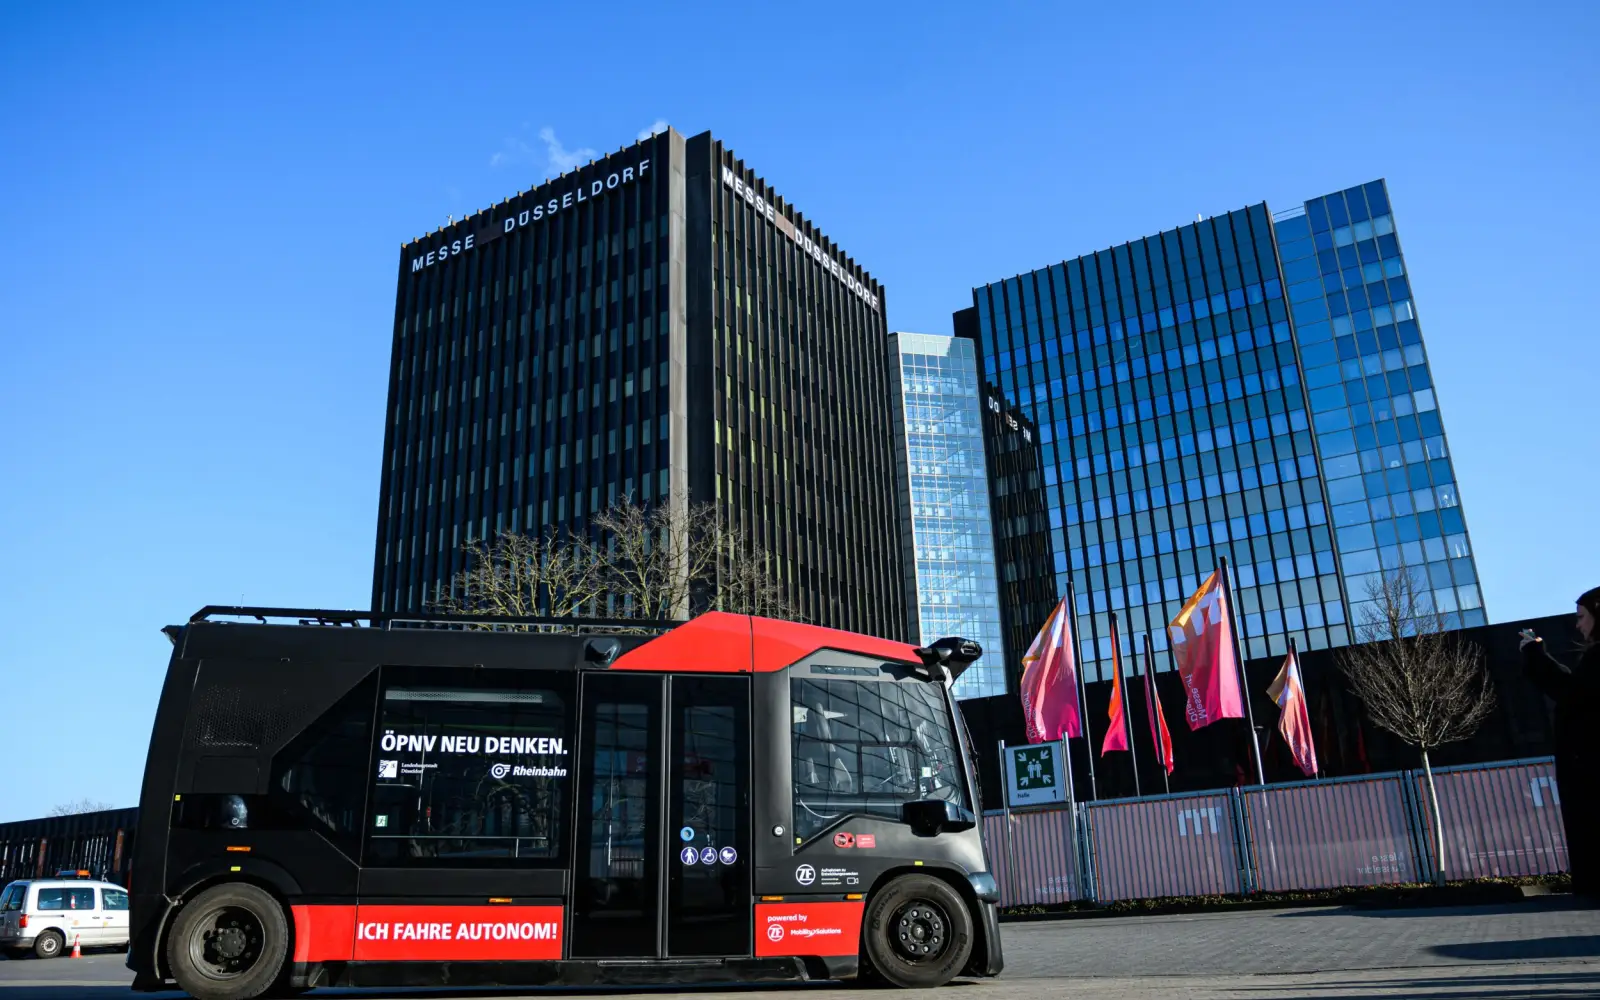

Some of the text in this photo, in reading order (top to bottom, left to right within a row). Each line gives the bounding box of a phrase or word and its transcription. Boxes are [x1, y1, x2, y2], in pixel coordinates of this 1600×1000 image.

[411, 158, 650, 273] MESSE DÜSSELDORF
[722, 165, 879, 308] MESSE DÜSSELDORF
[381, 730, 568, 755] ÖPNV NEU DENKEN.
[512, 765, 567, 777] Rheinbahn
[1052, 789, 1057, 799] 1
[796, 867, 815, 882] ZF
[767, 913, 807, 923] powered by
[357, 922, 557, 940] ICH FAHRE AUTONOM!
[768, 926, 784, 939] ZF
